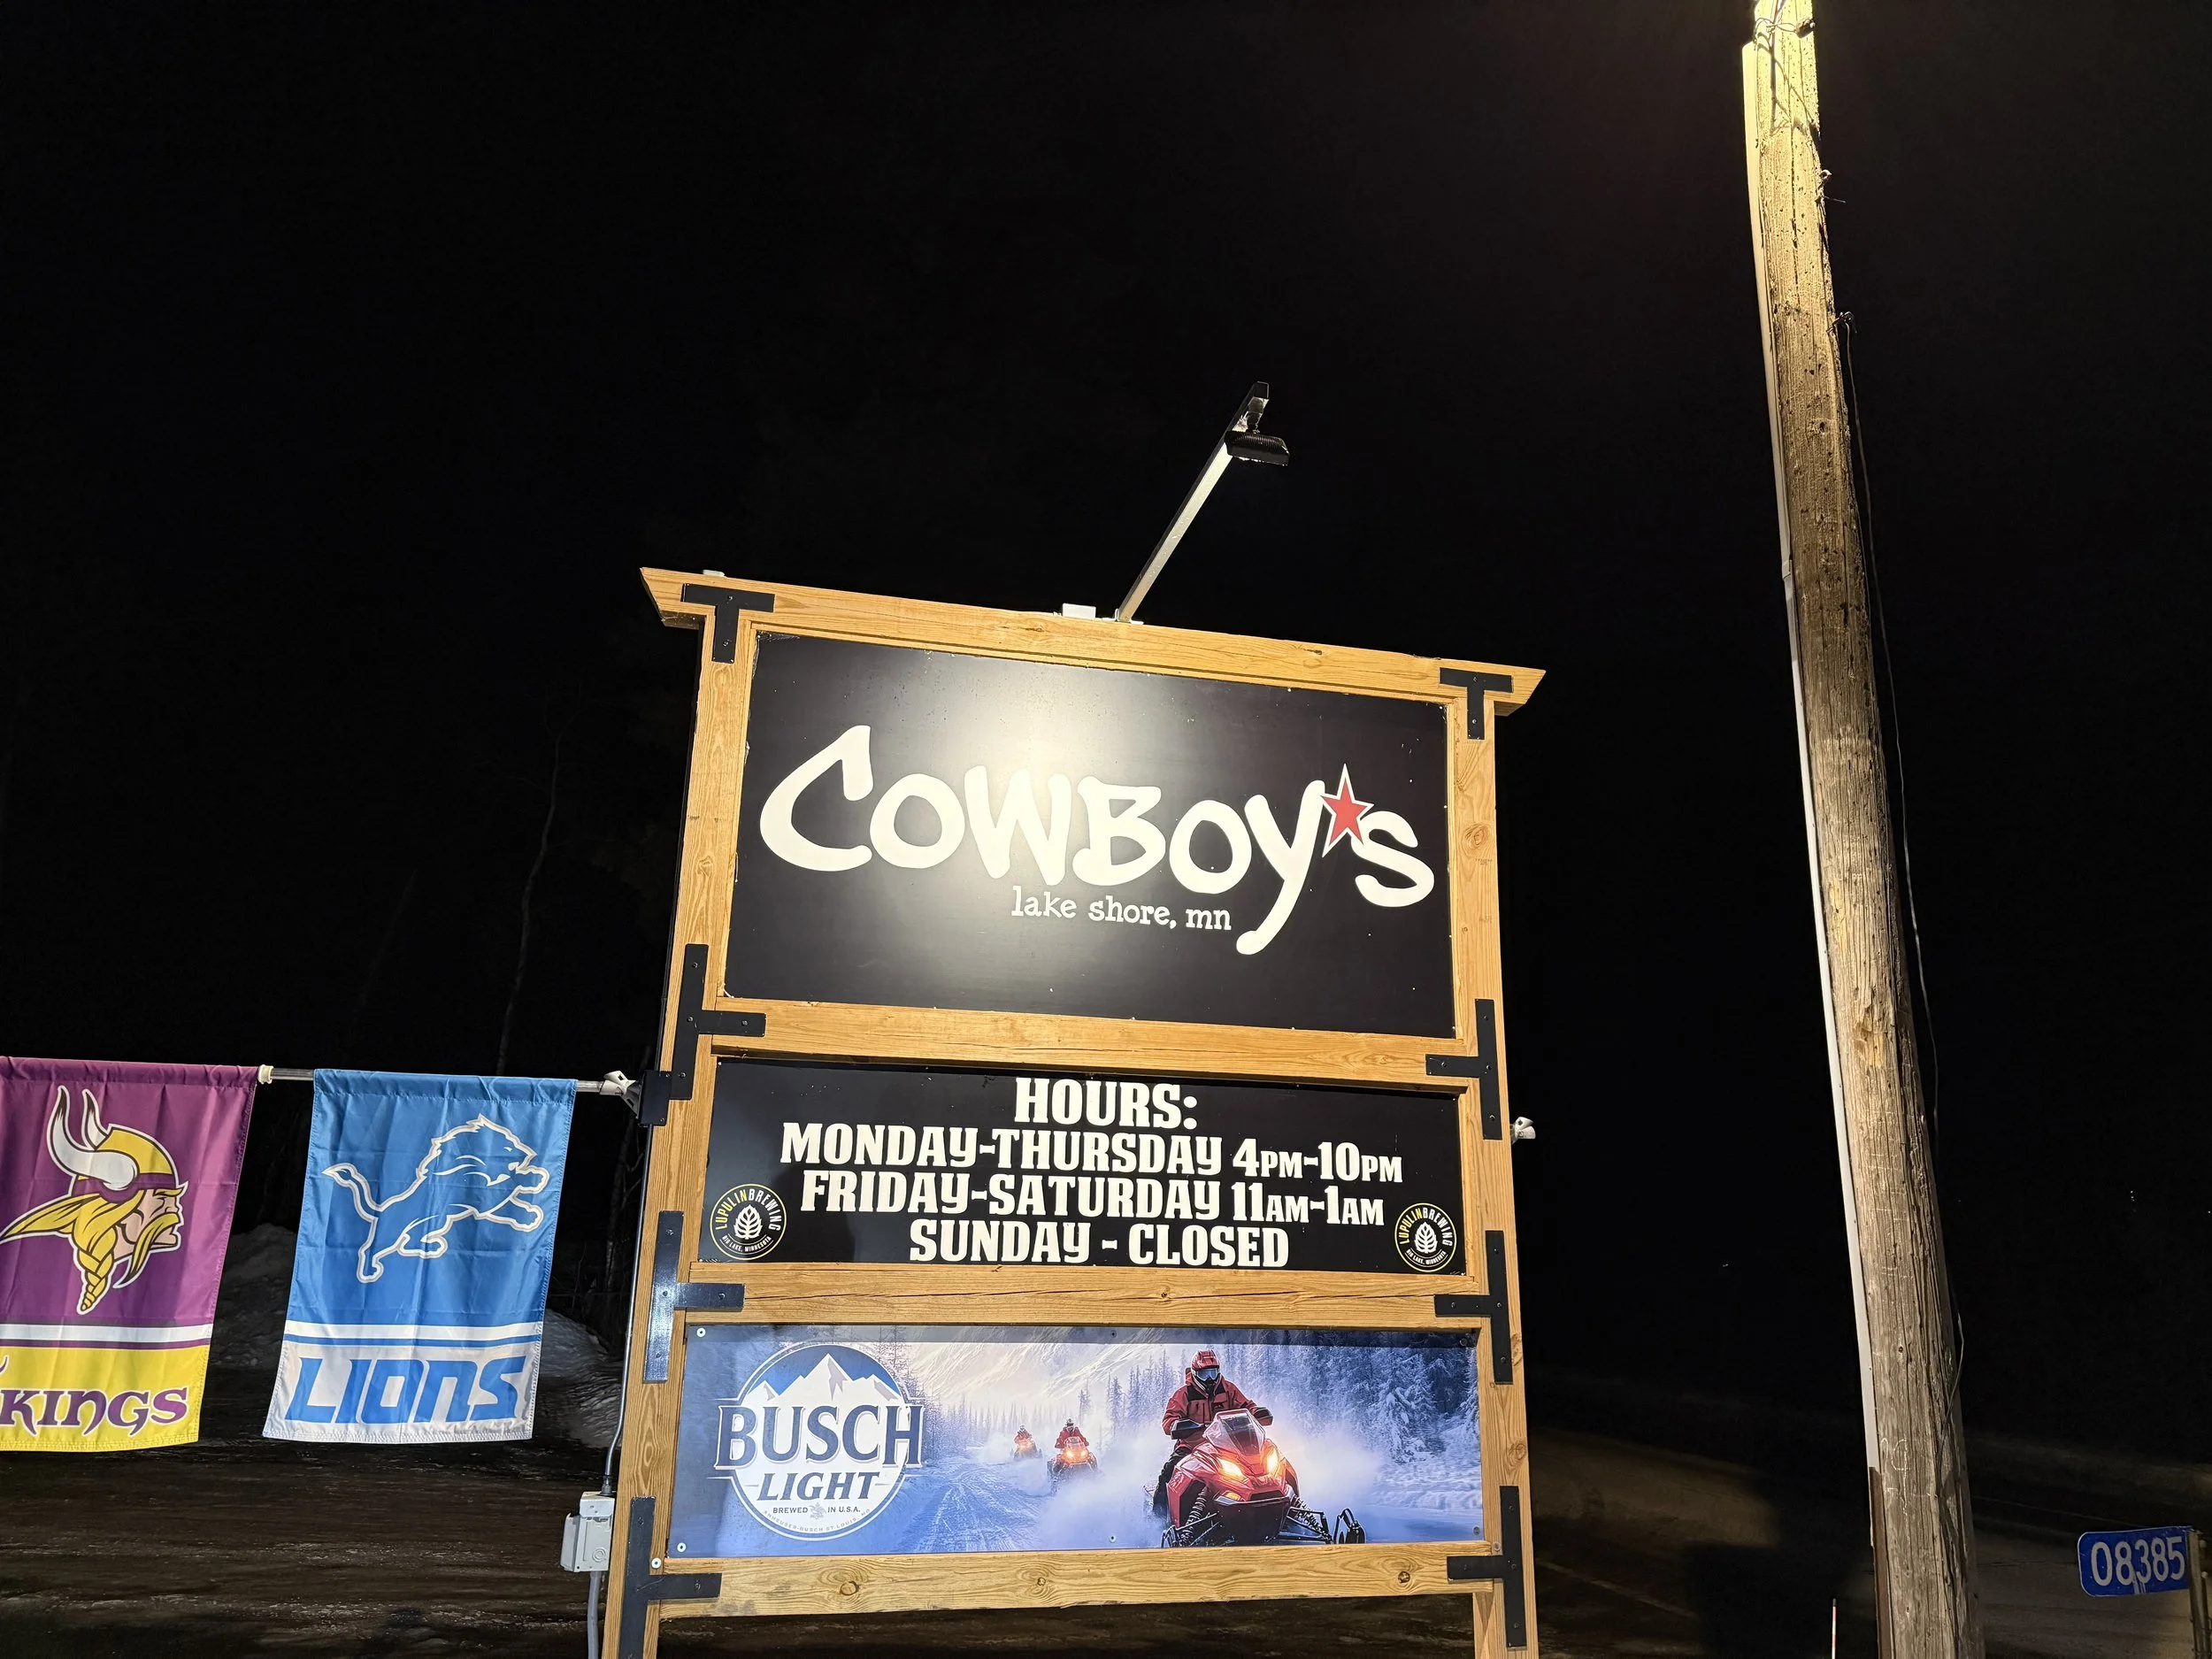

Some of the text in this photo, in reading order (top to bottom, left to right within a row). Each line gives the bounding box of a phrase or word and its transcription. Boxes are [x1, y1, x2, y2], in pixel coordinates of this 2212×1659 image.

[1011, 886, 1232, 932] lake shore, mn
[1015, 1078, 1197, 1129] HOURS:
[1232, 1138, 1403, 1183] 4PM-10PM
[1231, 1181, 1385, 1225] 11AM-1AM
[745, 1236, 772, 1252] MINNESOTA
[910, 1219, 1090, 1266] SUNDAY
[1127, 1226, 1288, 1268] CLOSED
[0, 1386, 188, 1437] KINGS
[285, 1356, 526, 1425] LIONS
[714, 1404, 924, 1470] BUSCH
[757, 1471, 880, 1501] LIGHT
[2091, 1536, 2185, 1586] 08385
